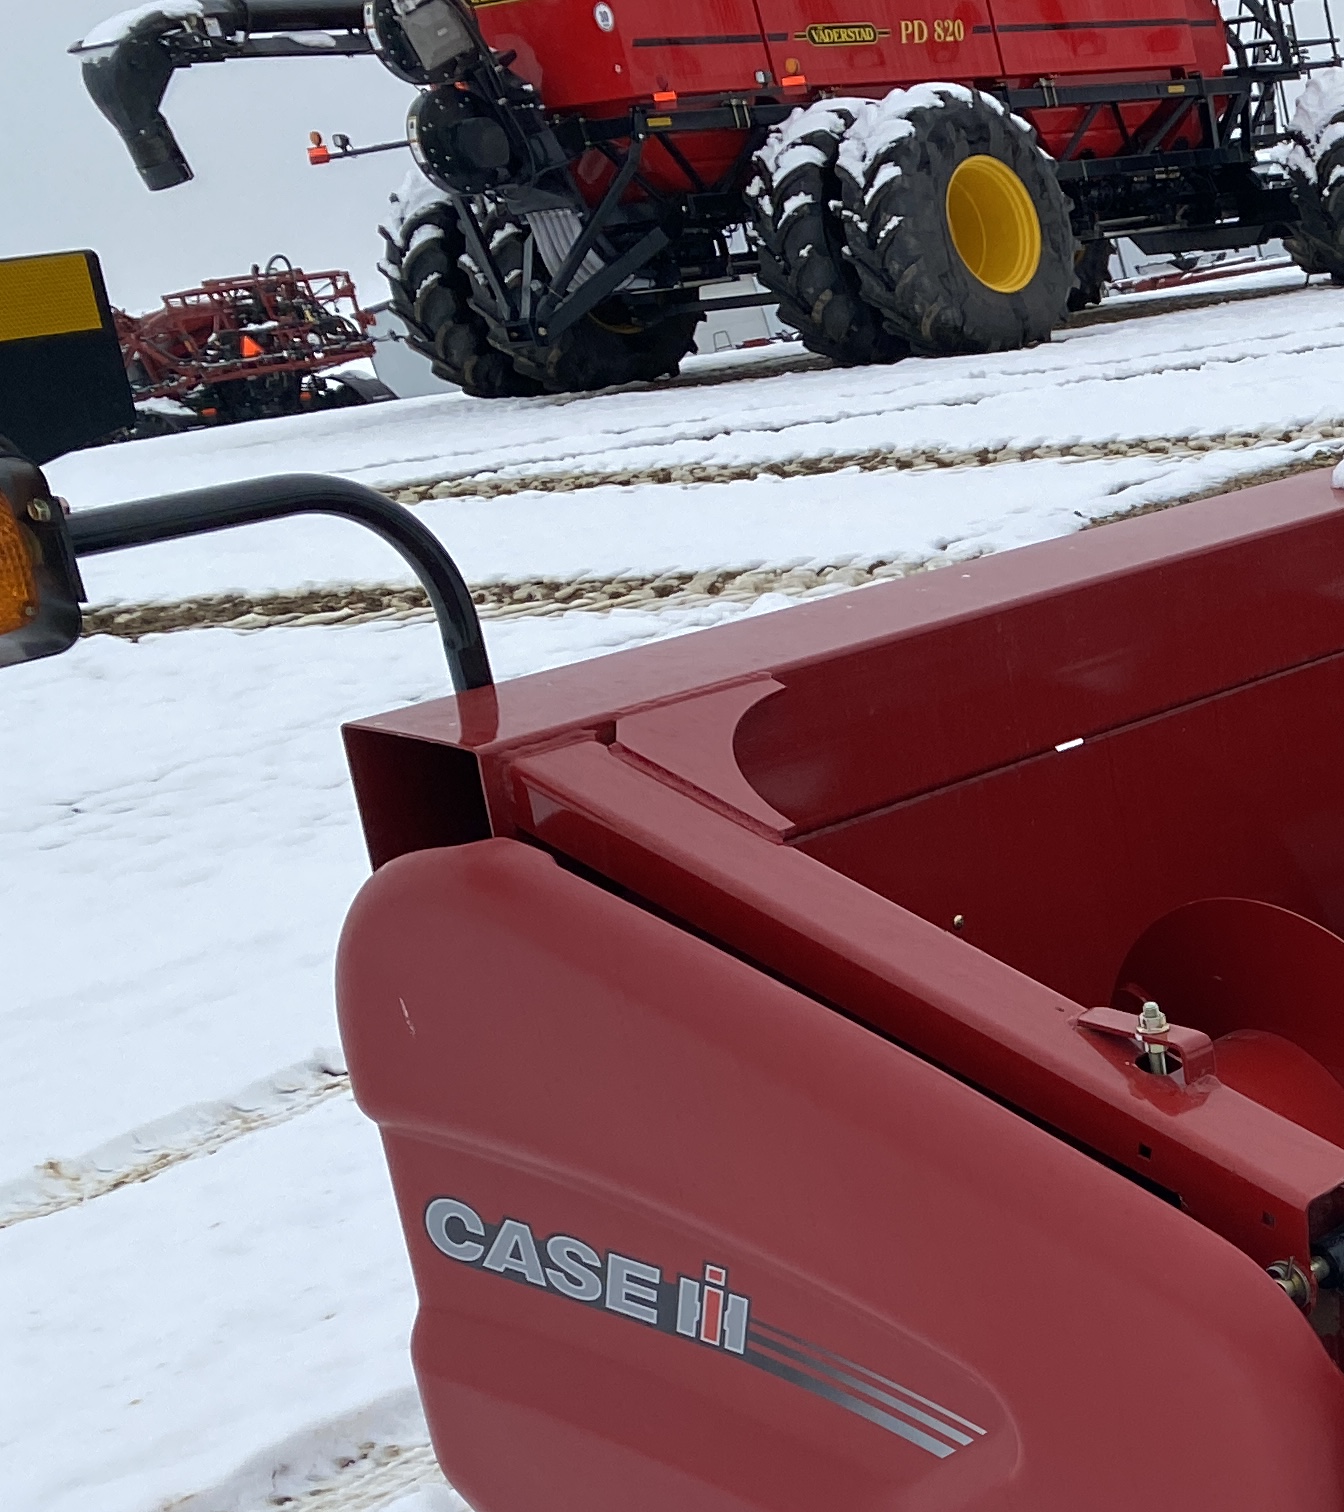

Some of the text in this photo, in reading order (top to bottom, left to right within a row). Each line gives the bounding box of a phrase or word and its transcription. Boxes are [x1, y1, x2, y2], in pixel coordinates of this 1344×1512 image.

[901, 20, 928, 44] PD
[934, 19, 965, 42] 820
[424, 1198, 661, 1325] CASE
